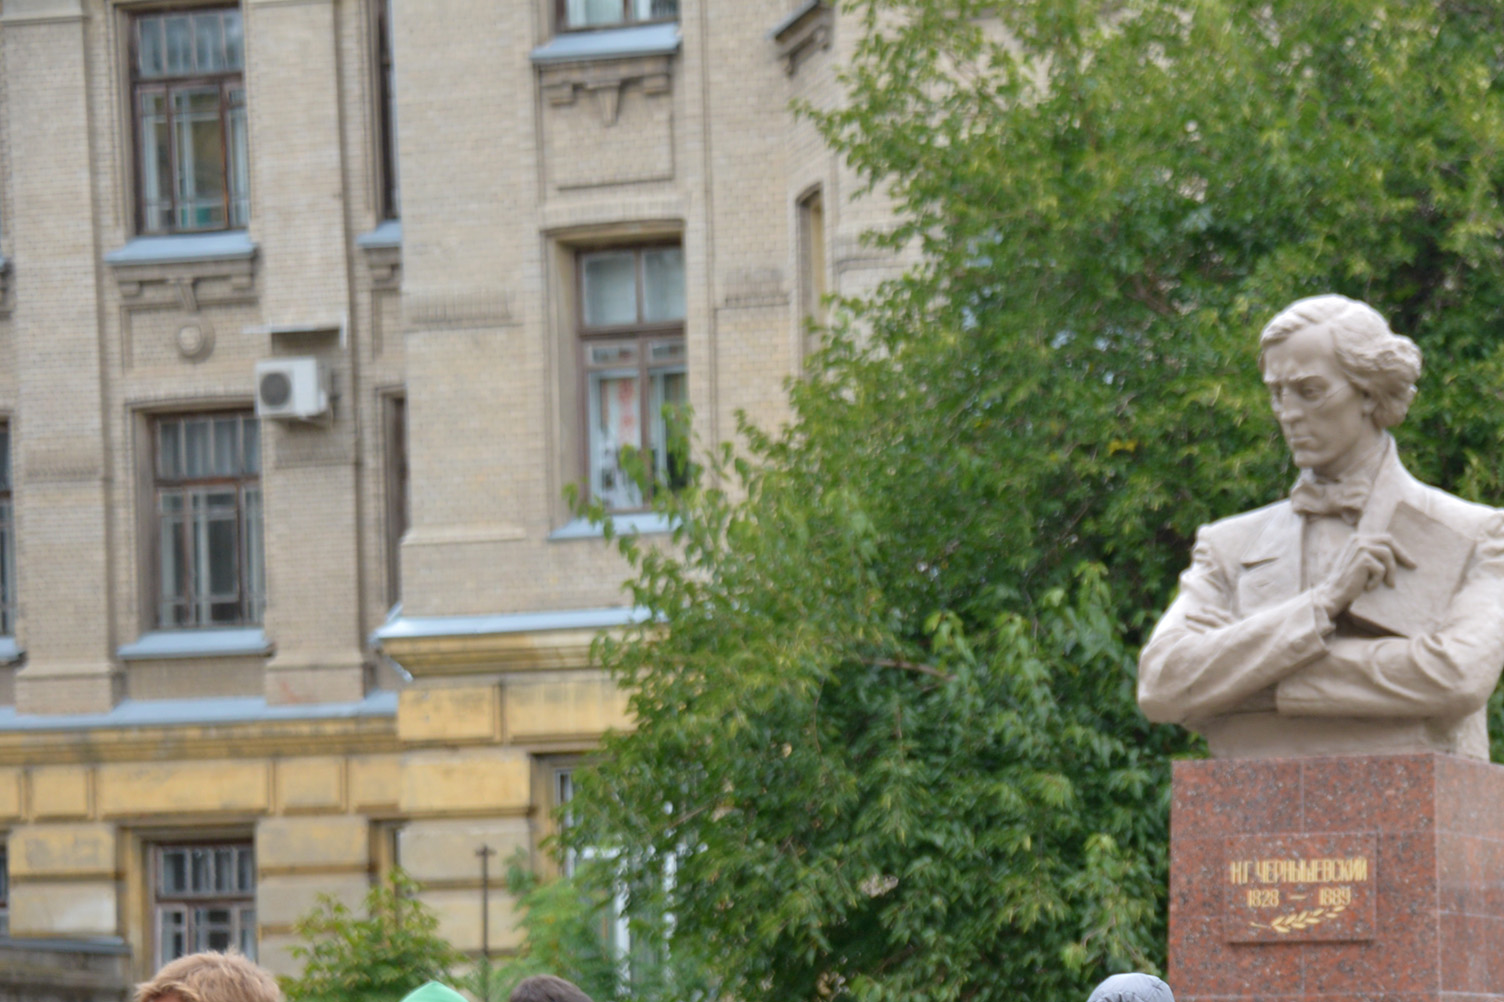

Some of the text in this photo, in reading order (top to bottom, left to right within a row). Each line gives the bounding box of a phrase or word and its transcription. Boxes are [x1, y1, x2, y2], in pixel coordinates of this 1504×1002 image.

[1255, 857, 1367, 884] ЧЕРНЫШЕВСКИЙ
[1248, 889, 1279, 908] 1828
[1319, 886, 1351, 906] 1889
